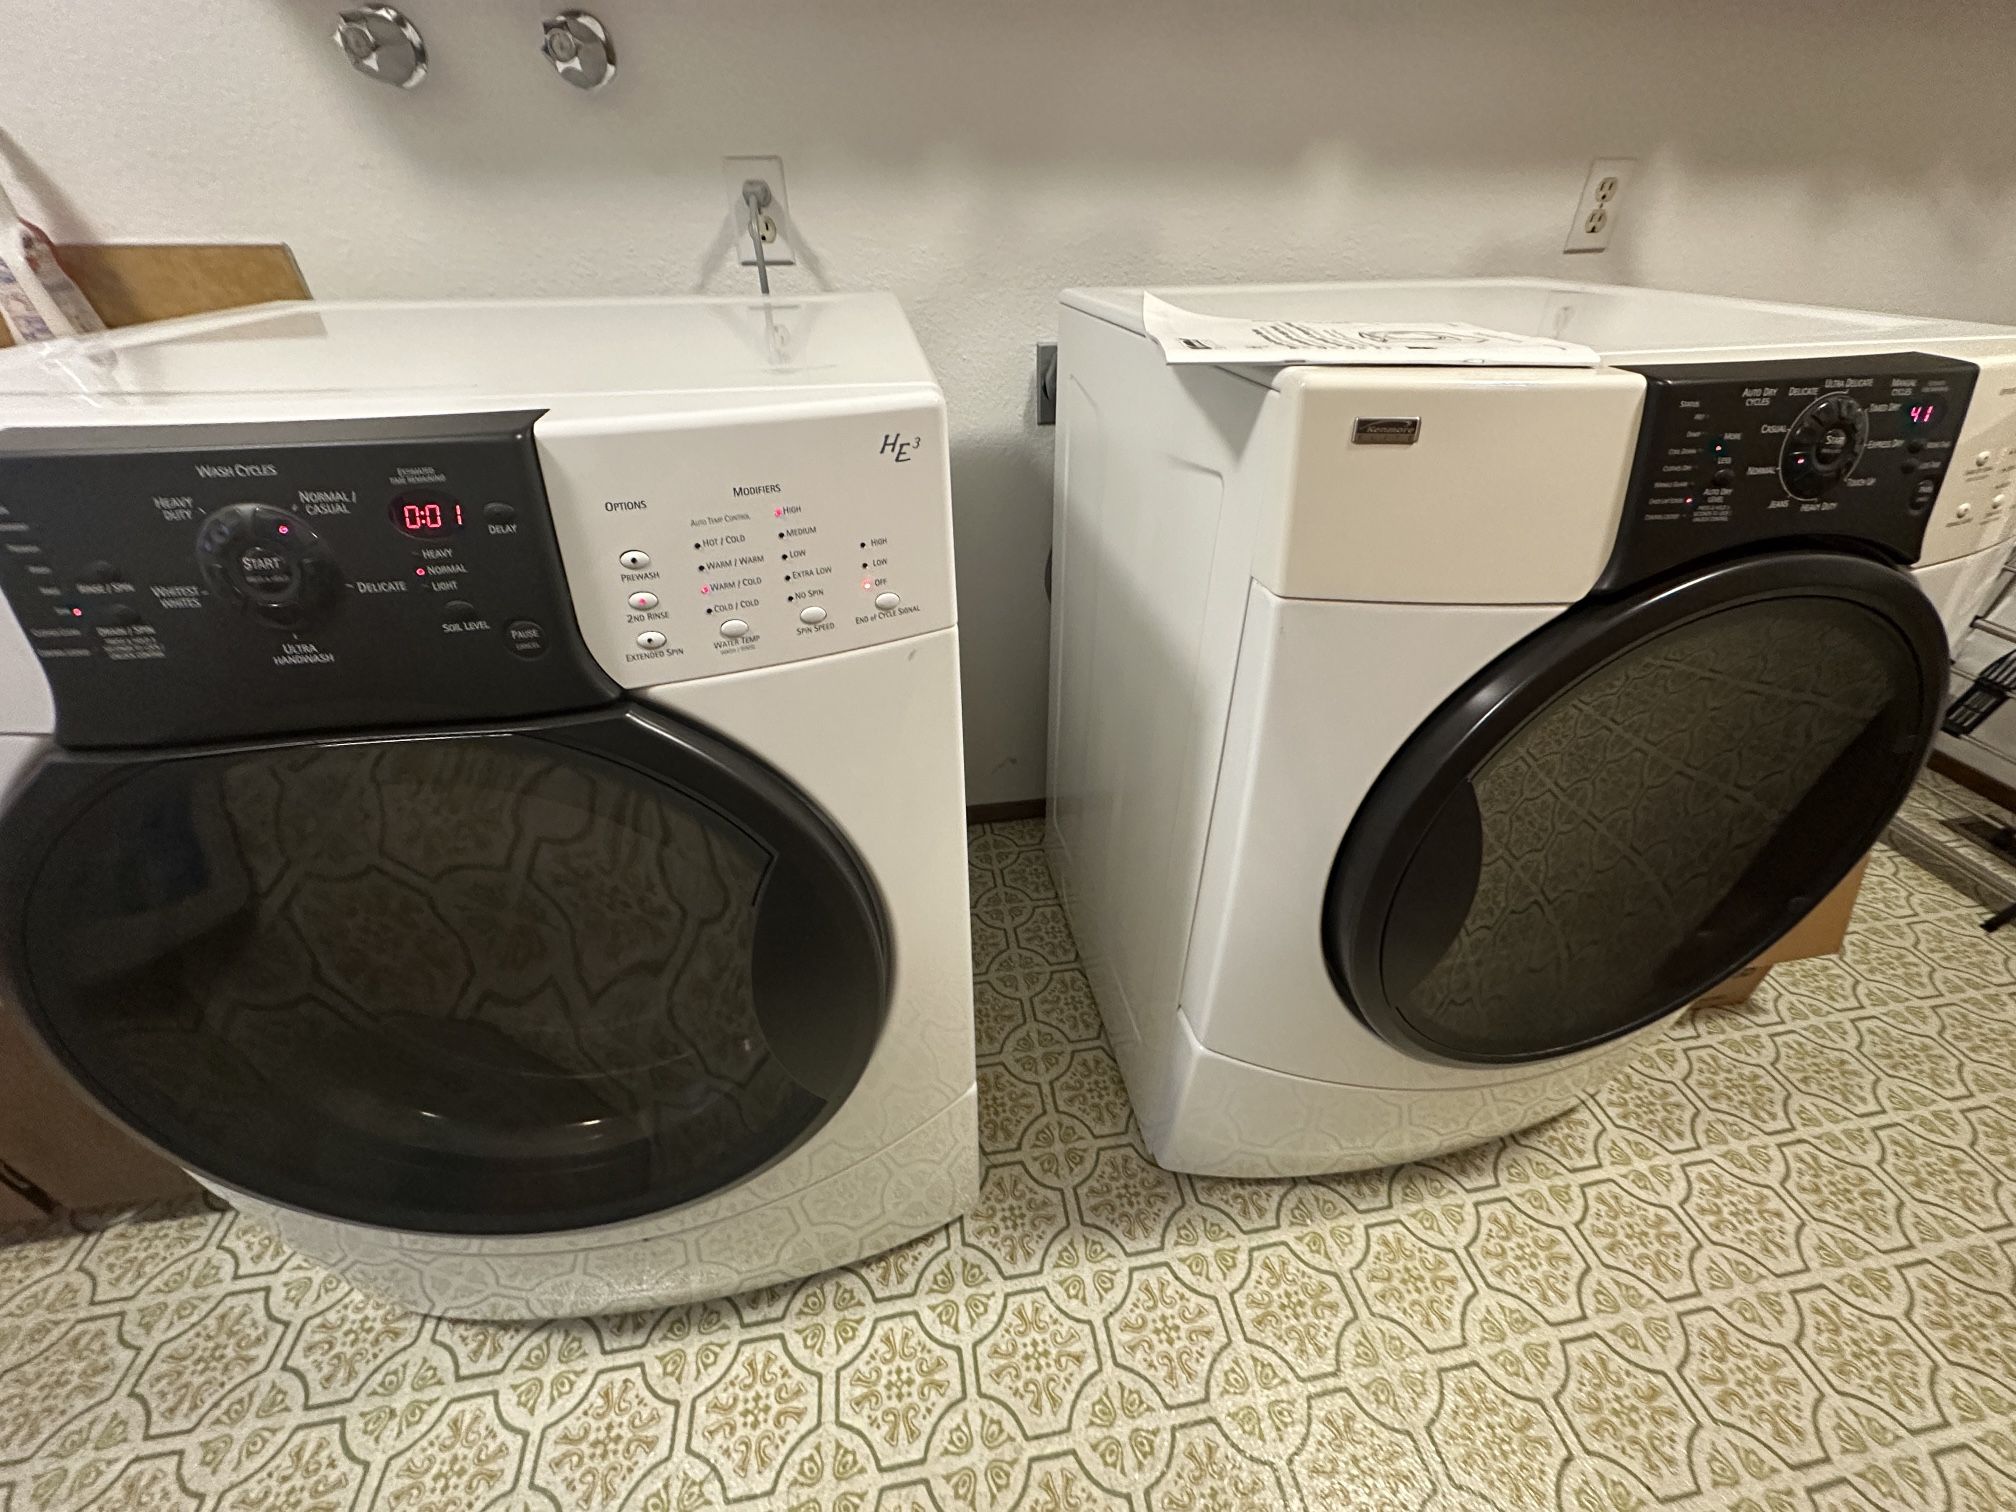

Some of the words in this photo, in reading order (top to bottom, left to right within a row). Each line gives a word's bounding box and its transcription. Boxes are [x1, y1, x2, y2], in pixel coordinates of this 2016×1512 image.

[1825, 379, 1844, 388] ULTRA
[1846, 378, 1874, 387] DELICATE
[1742, 388, 1762, 397] AUTO
[1763, 388, 1778, 396] DRY
[1788, 387, 1819, 396] DELICATE
[1745, 398, 1770, 406] CYCLES
[1910, 405, 1934, 422] 41
[1761, 425, 1787, 433] CASUAL
[194, 465, 234, 478] WASH
[234, 464, 278, 477] CYCLES
[1747, 467, 1776, 475] NORMAL
[733, 483, 781, 498] MODIFIERS
[153, 497, 193, 509] HEAVY
[298, 491, 350, 503] NORMAL
[305, 504, 350, 515] CASUAL
[604, 500, 647, 512] OPTIONS
[782, 505, 802, 515] HIGH
[1767, 500, 1789, 509] JEANS
[162, 509, 192, 521] DUTY
[403, 504, 462, 529] 0:01
[690, 519, 707, 527] AUTO
[707, 516, 723, 525] TEMP
[724, 513, 751, 523] CONTROL
[488, 524, 518, 535] DELAY
[786, 526, 817, 537] MEDIUM
[702, 539, 718, 548] HOT
[725, 534, 746, 544] COLD
[870, 537, 888, 547] HIGH
[421, 548, 453, 559] HEAVY
[789, 549, 806, 559] LOW
[242, 557, 280, 571] START
[706, 559, 732, 571] WARM
[738, 555, 765, 566] WARM
[872, 558, 888, 567] LOW
[427, 564, 468, 575] NORMAL
[792, 569, 814, 580] EXTRA
[816, 566, 832, 576] LOW
[620, 571, 660, 583] PREWASH
[874, 577, 888, 587] OFF
[356, 581, 408, 593] DELICATE
[431, 580, 459, 592] LIGHT
[709, 581, 736, 592] WARM
[742, 577, 762, 587] COLD
[150, 586, 200, 597] WHITEST
[794, 591, 807, 601] NO
[808, 589, 824, 599] SPIN
[159, 598, 202, 609] WHITES
[714, 603, 733, 613] COLD
[740, 599, 760, 609] COLD
[626, 614, 645, 623] 2ND
[647, 611, 670, 621] RINSE
[855, 615, 869, 625] END
[878, 610, 898, 621] CYCLE
[898, 605, 920, 616] SIGNAL
[441, 622, 463, 633] SOIL
[463, 620, 491, 631] LEVEL
[796, 626, 812, 636] SPIN
[814, 622, 835, 632] SPEED
[511, 629, 541, 639] PAUSE
[713, 638, 740, 650] WATER
[741, 635, 760, 645] TEMP
[282, 644, 319, 654] ULTRA
[273, 653, 335, 665] HANDWASH
[626, 651, 665, 663] EXTENDED
[666, 648, 684, 657] SPIN
